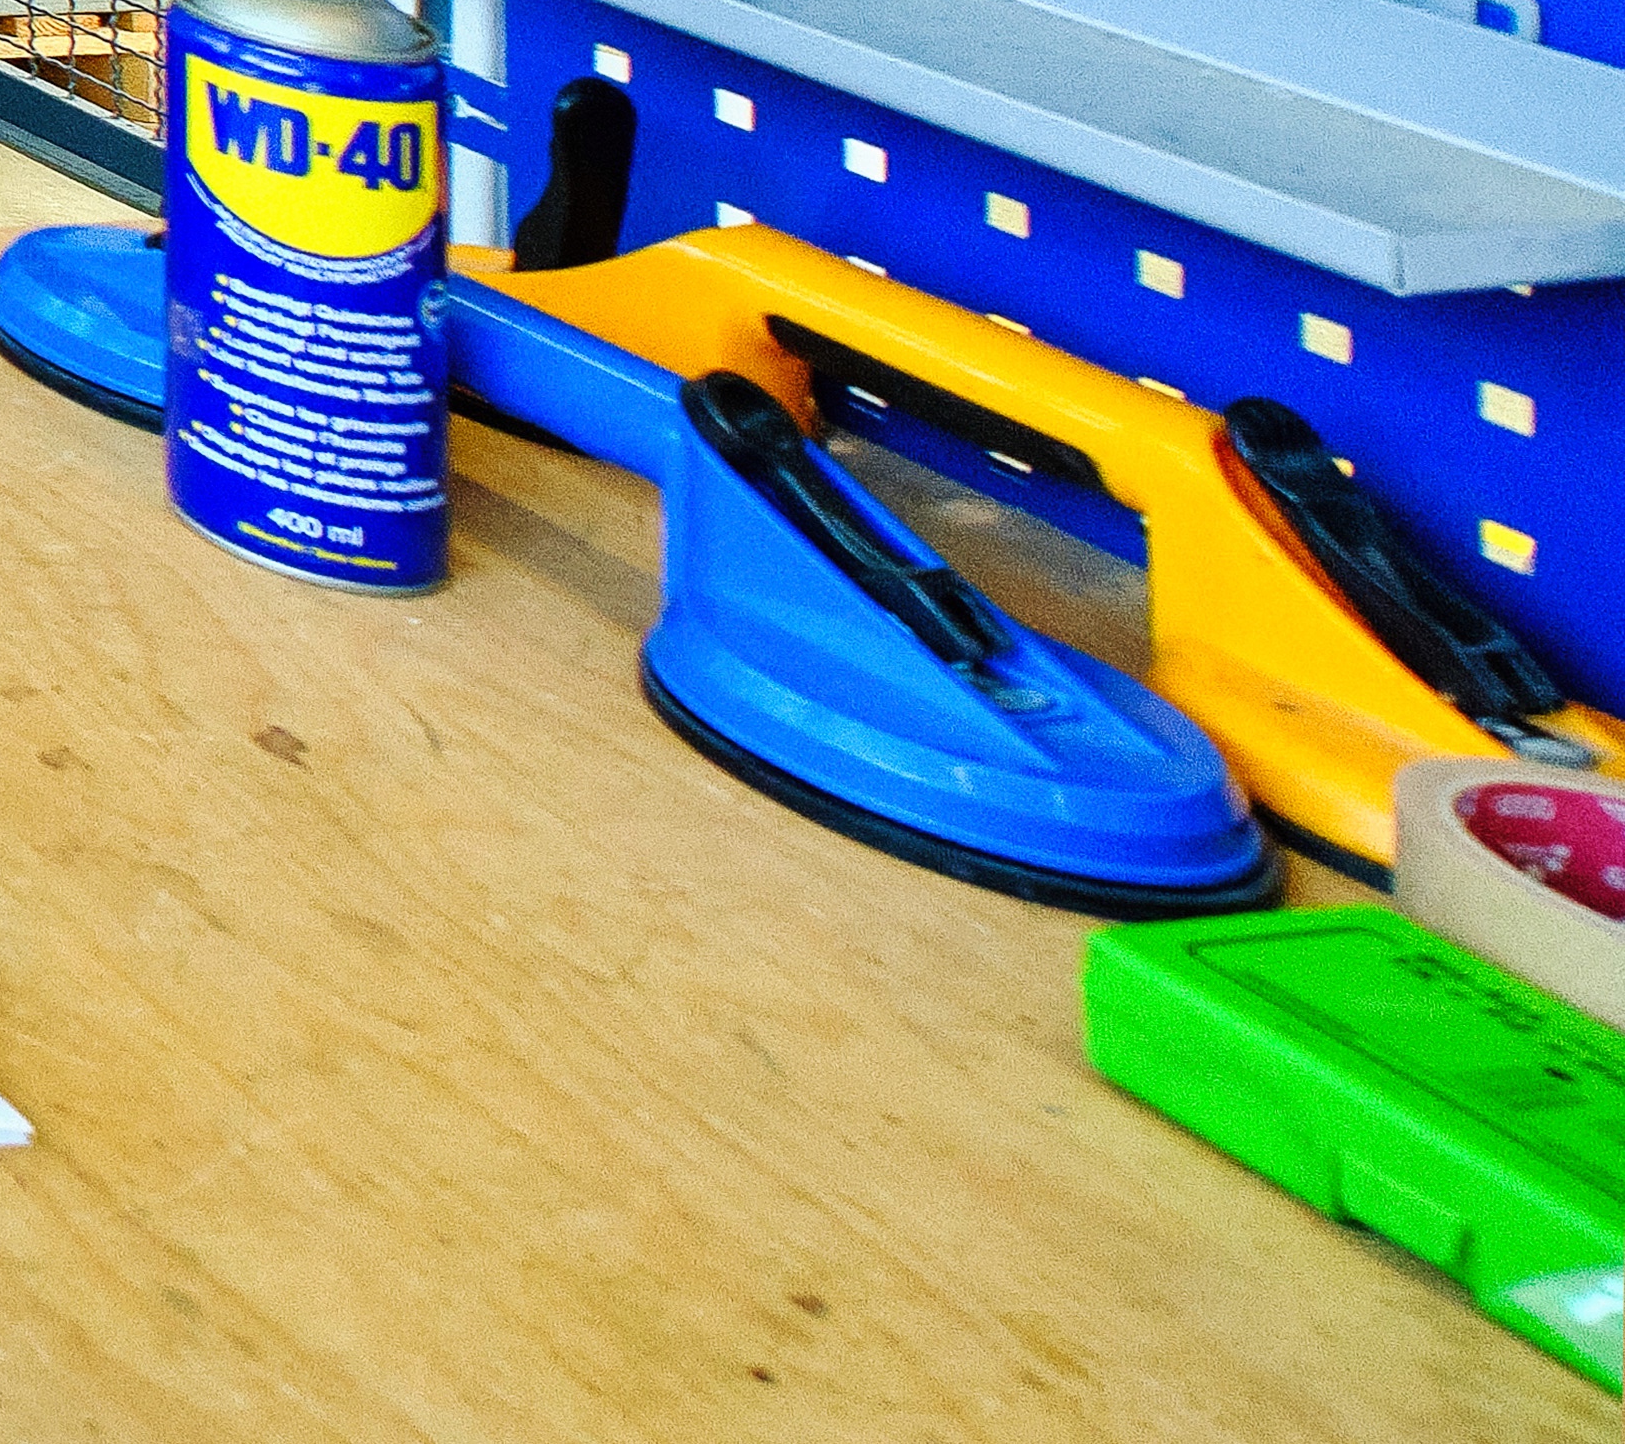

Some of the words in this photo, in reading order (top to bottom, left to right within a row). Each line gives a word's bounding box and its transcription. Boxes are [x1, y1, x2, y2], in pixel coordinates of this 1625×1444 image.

[205, 80, 422, 192] WD-40
[265, 507, 324, 539] 400
[327, 525, 364, 548] ml
